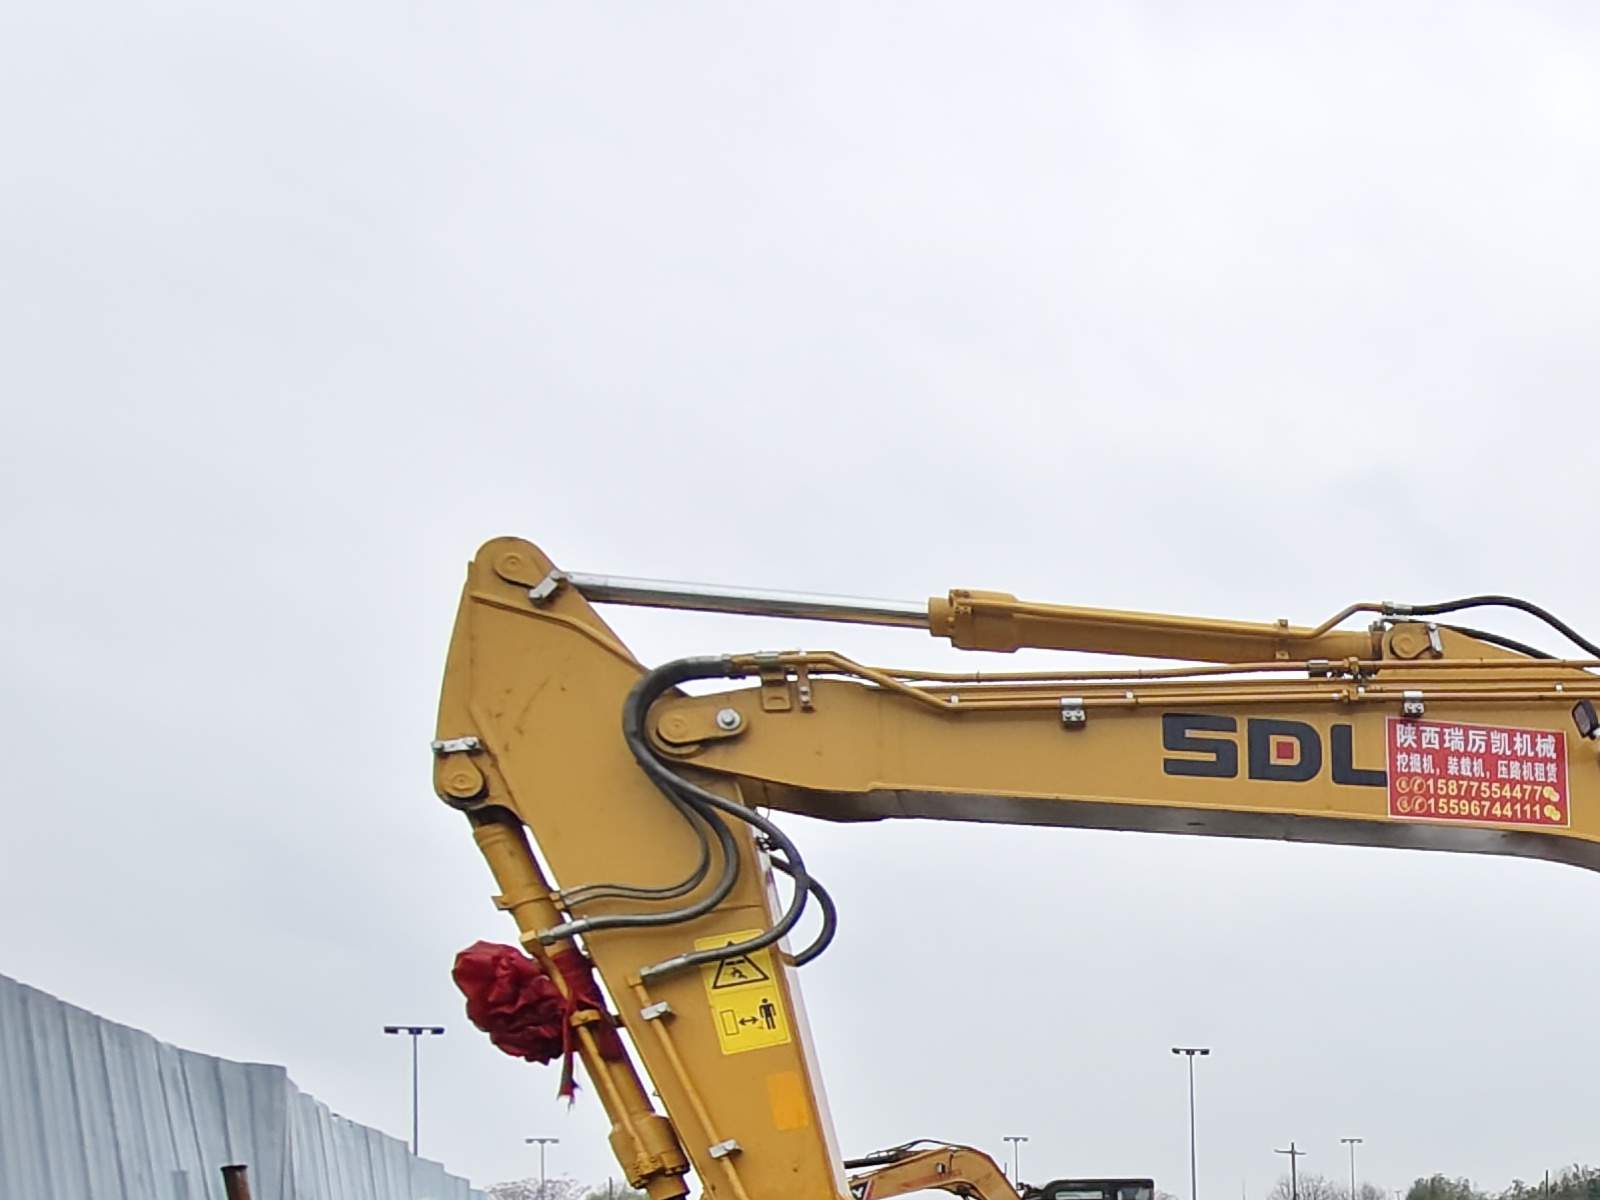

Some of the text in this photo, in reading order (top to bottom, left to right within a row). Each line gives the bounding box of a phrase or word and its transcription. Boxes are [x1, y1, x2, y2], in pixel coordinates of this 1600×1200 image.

[1395, 723, 1558, 760] 陕西瑞厉凯机械
[1426, 777, 1543, 800] 15877554477
[1427, 798, 1541, 820] 15596744111
